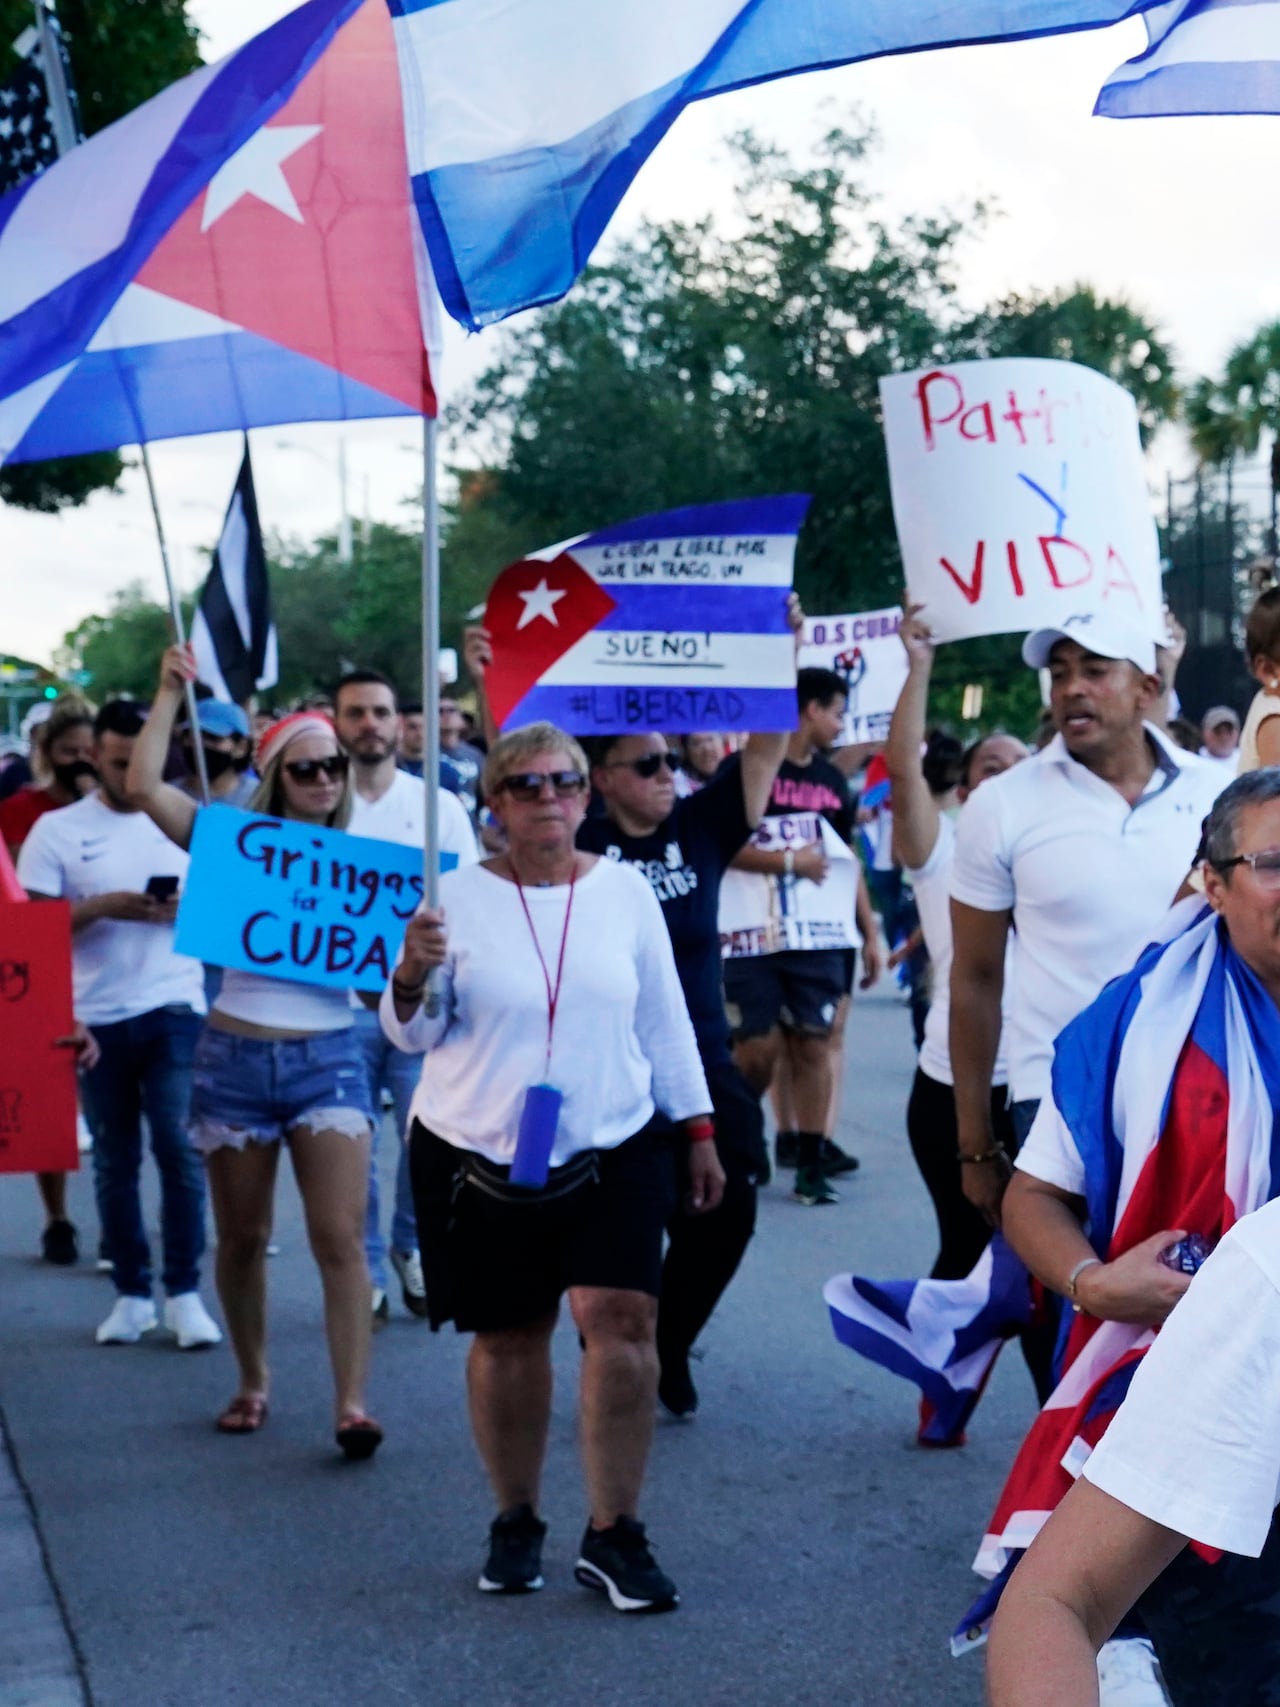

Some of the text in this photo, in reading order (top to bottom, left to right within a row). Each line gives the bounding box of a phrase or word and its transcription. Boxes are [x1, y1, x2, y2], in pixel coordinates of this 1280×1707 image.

[939, 536, 1145, 609] VIDA
[569, 688, 746, 725] #LIBERTAD
[241, 911, 389, 979] CUBA
